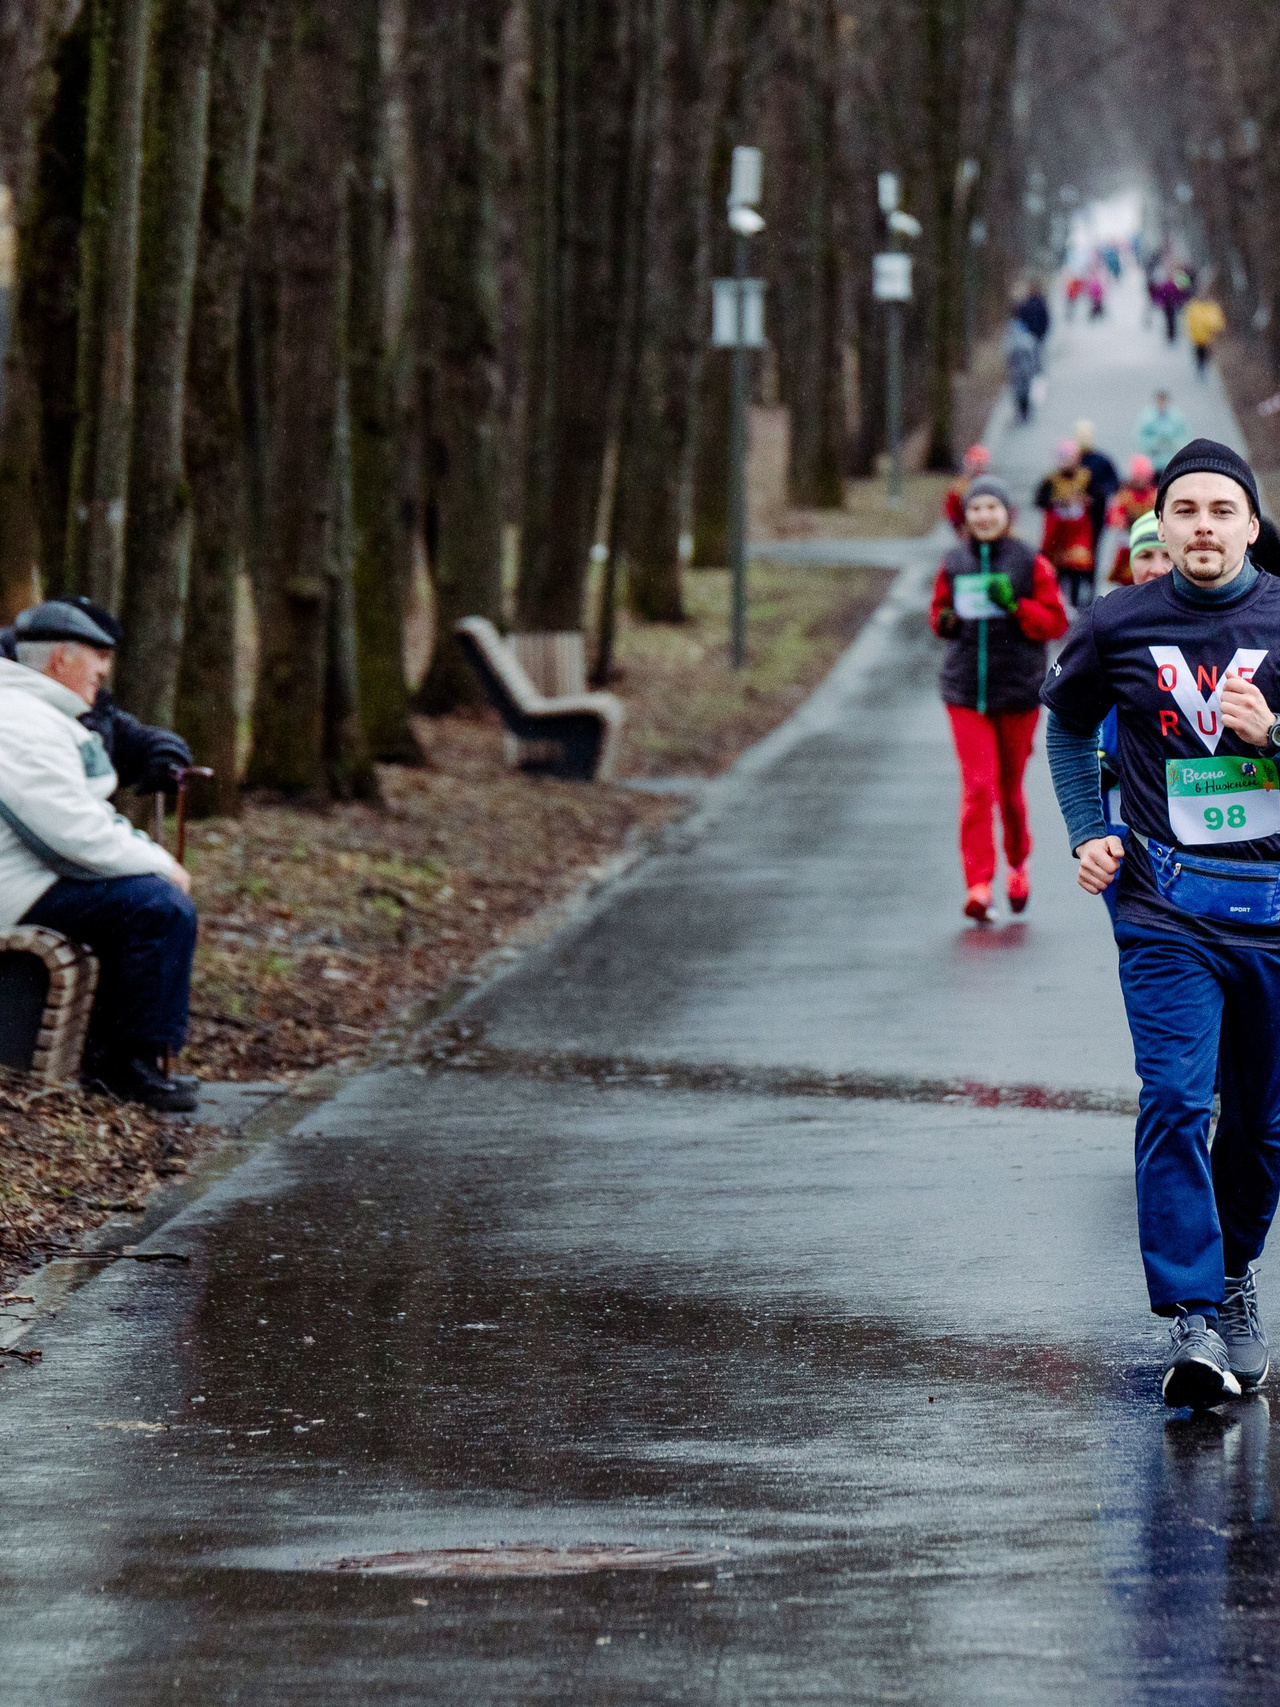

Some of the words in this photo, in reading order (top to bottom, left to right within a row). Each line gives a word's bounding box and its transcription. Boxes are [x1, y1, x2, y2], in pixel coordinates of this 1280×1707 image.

[1157, 664, 1254, 692] ONE
[1159, 710, 1218, 736] RU
[1182, 768, 1227, 784] Весна
[1203, 804, 1247, 831] 98
[1229, 905, 1251, 913] SPORT
